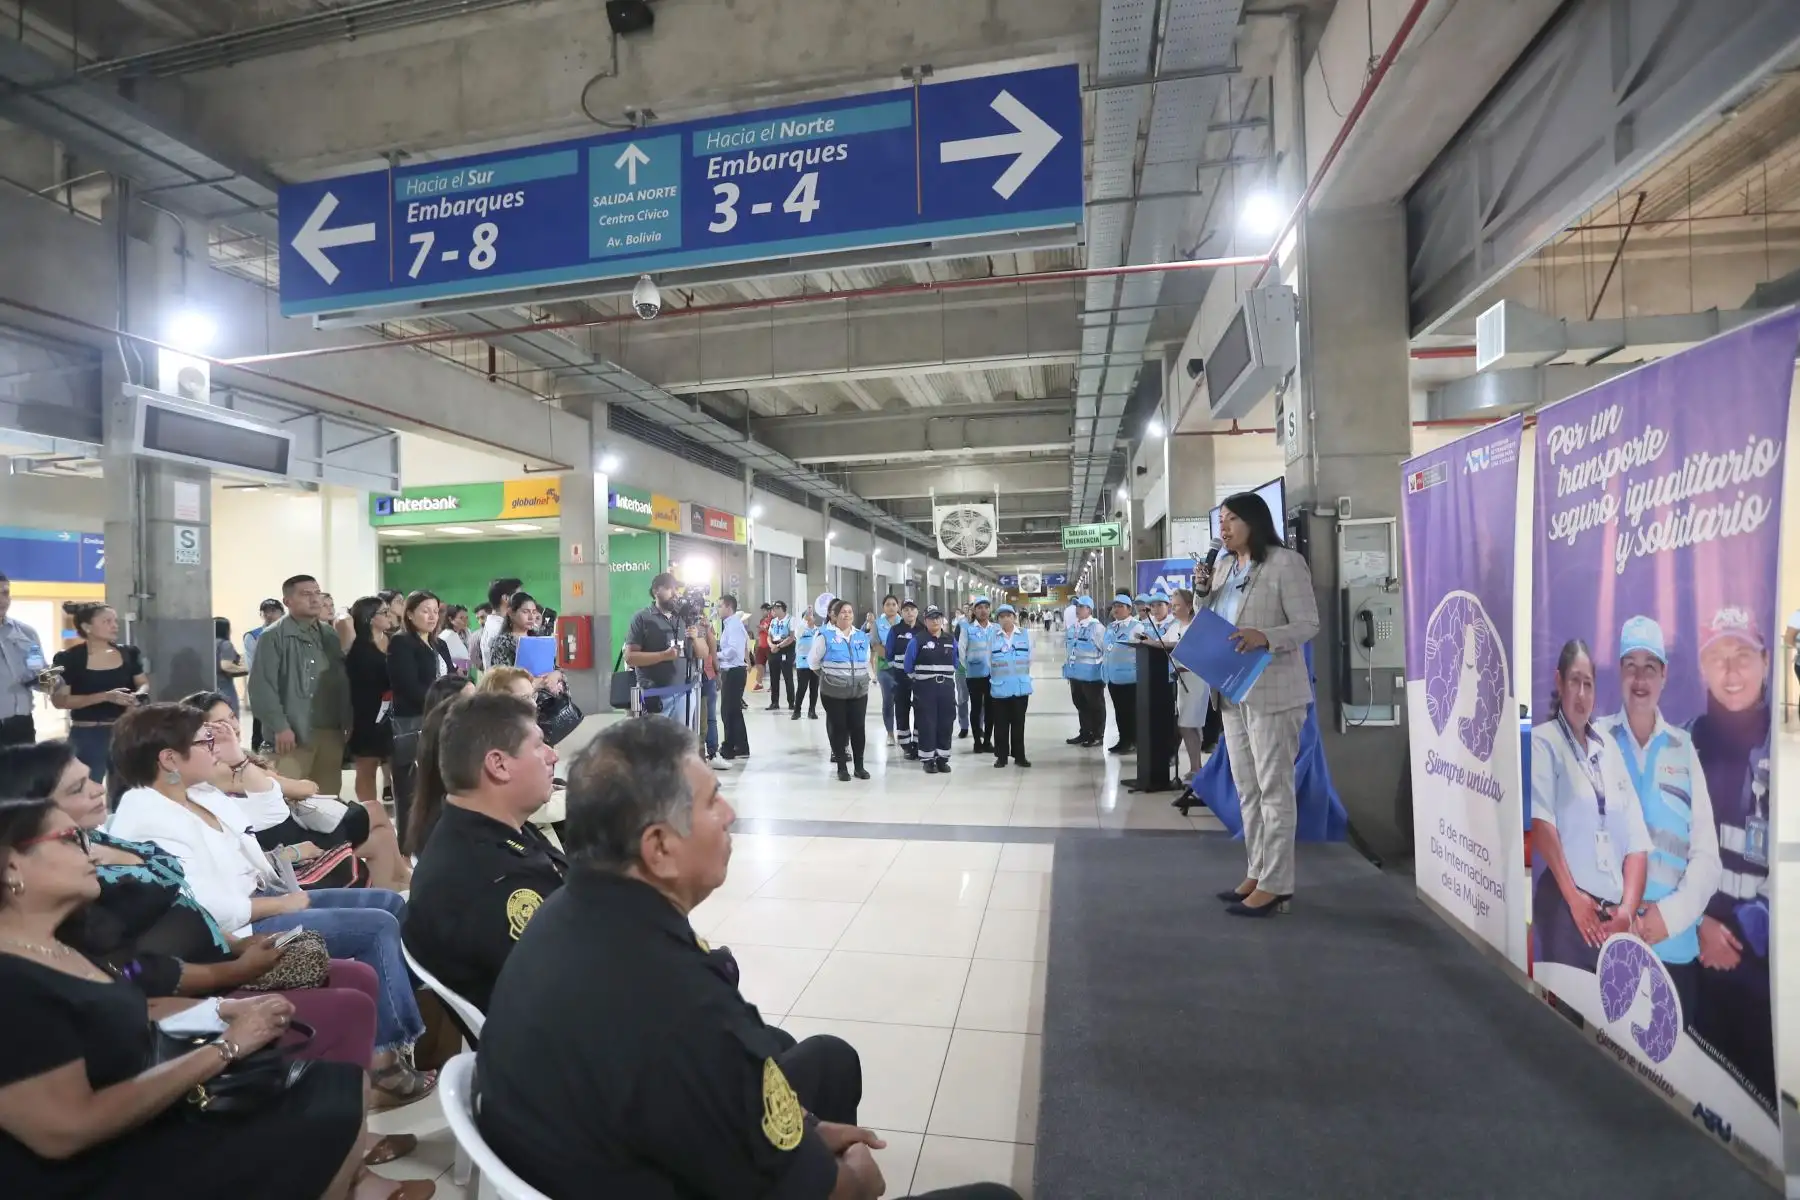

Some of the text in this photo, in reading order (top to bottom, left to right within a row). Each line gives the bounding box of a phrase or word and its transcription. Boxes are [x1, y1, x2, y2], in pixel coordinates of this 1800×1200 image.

[707, 117, 835, 149] Hacia el Norte
[707, 143, 848, 179] Embarques
[407, 169, 495, 195] Hacia el Sur
[593, 185, 678, 208] SALIDA NORTE
[407, 190, 525, 223] Embarques
[708, 182, 740, 234] 3
[782, 171, 821, 223] 4
[599, 213, 635, 226] Centro
[408, 231, 435, 280] 7
[468, 222, 499, 271] 8
[606, 231, 662, 248] Av. Bolivia
[1546, 422, 1588, 465] Por
[1588, 404, 1624, 444] un
[1557, 424, 1670, 498] transporte
[1624, 434, 1783, 527] igualitario
[393, 495, 457, 513] Interbank
[511, 496, 549, 509] globalnet
[616, 494, 653, 515] Interbank
[181, 529, 195, 548] S
[1615, 490, 1772, 575] y solidario
[1425, 748, 1506, 803] Siempre unidas
[1439, 818, 1446, 835] 8
[1447, 821, 1457, 841] de
[1444, 849, 1507, 902] Internacional
[1441, 871, 1491, 918] de la Mujer
